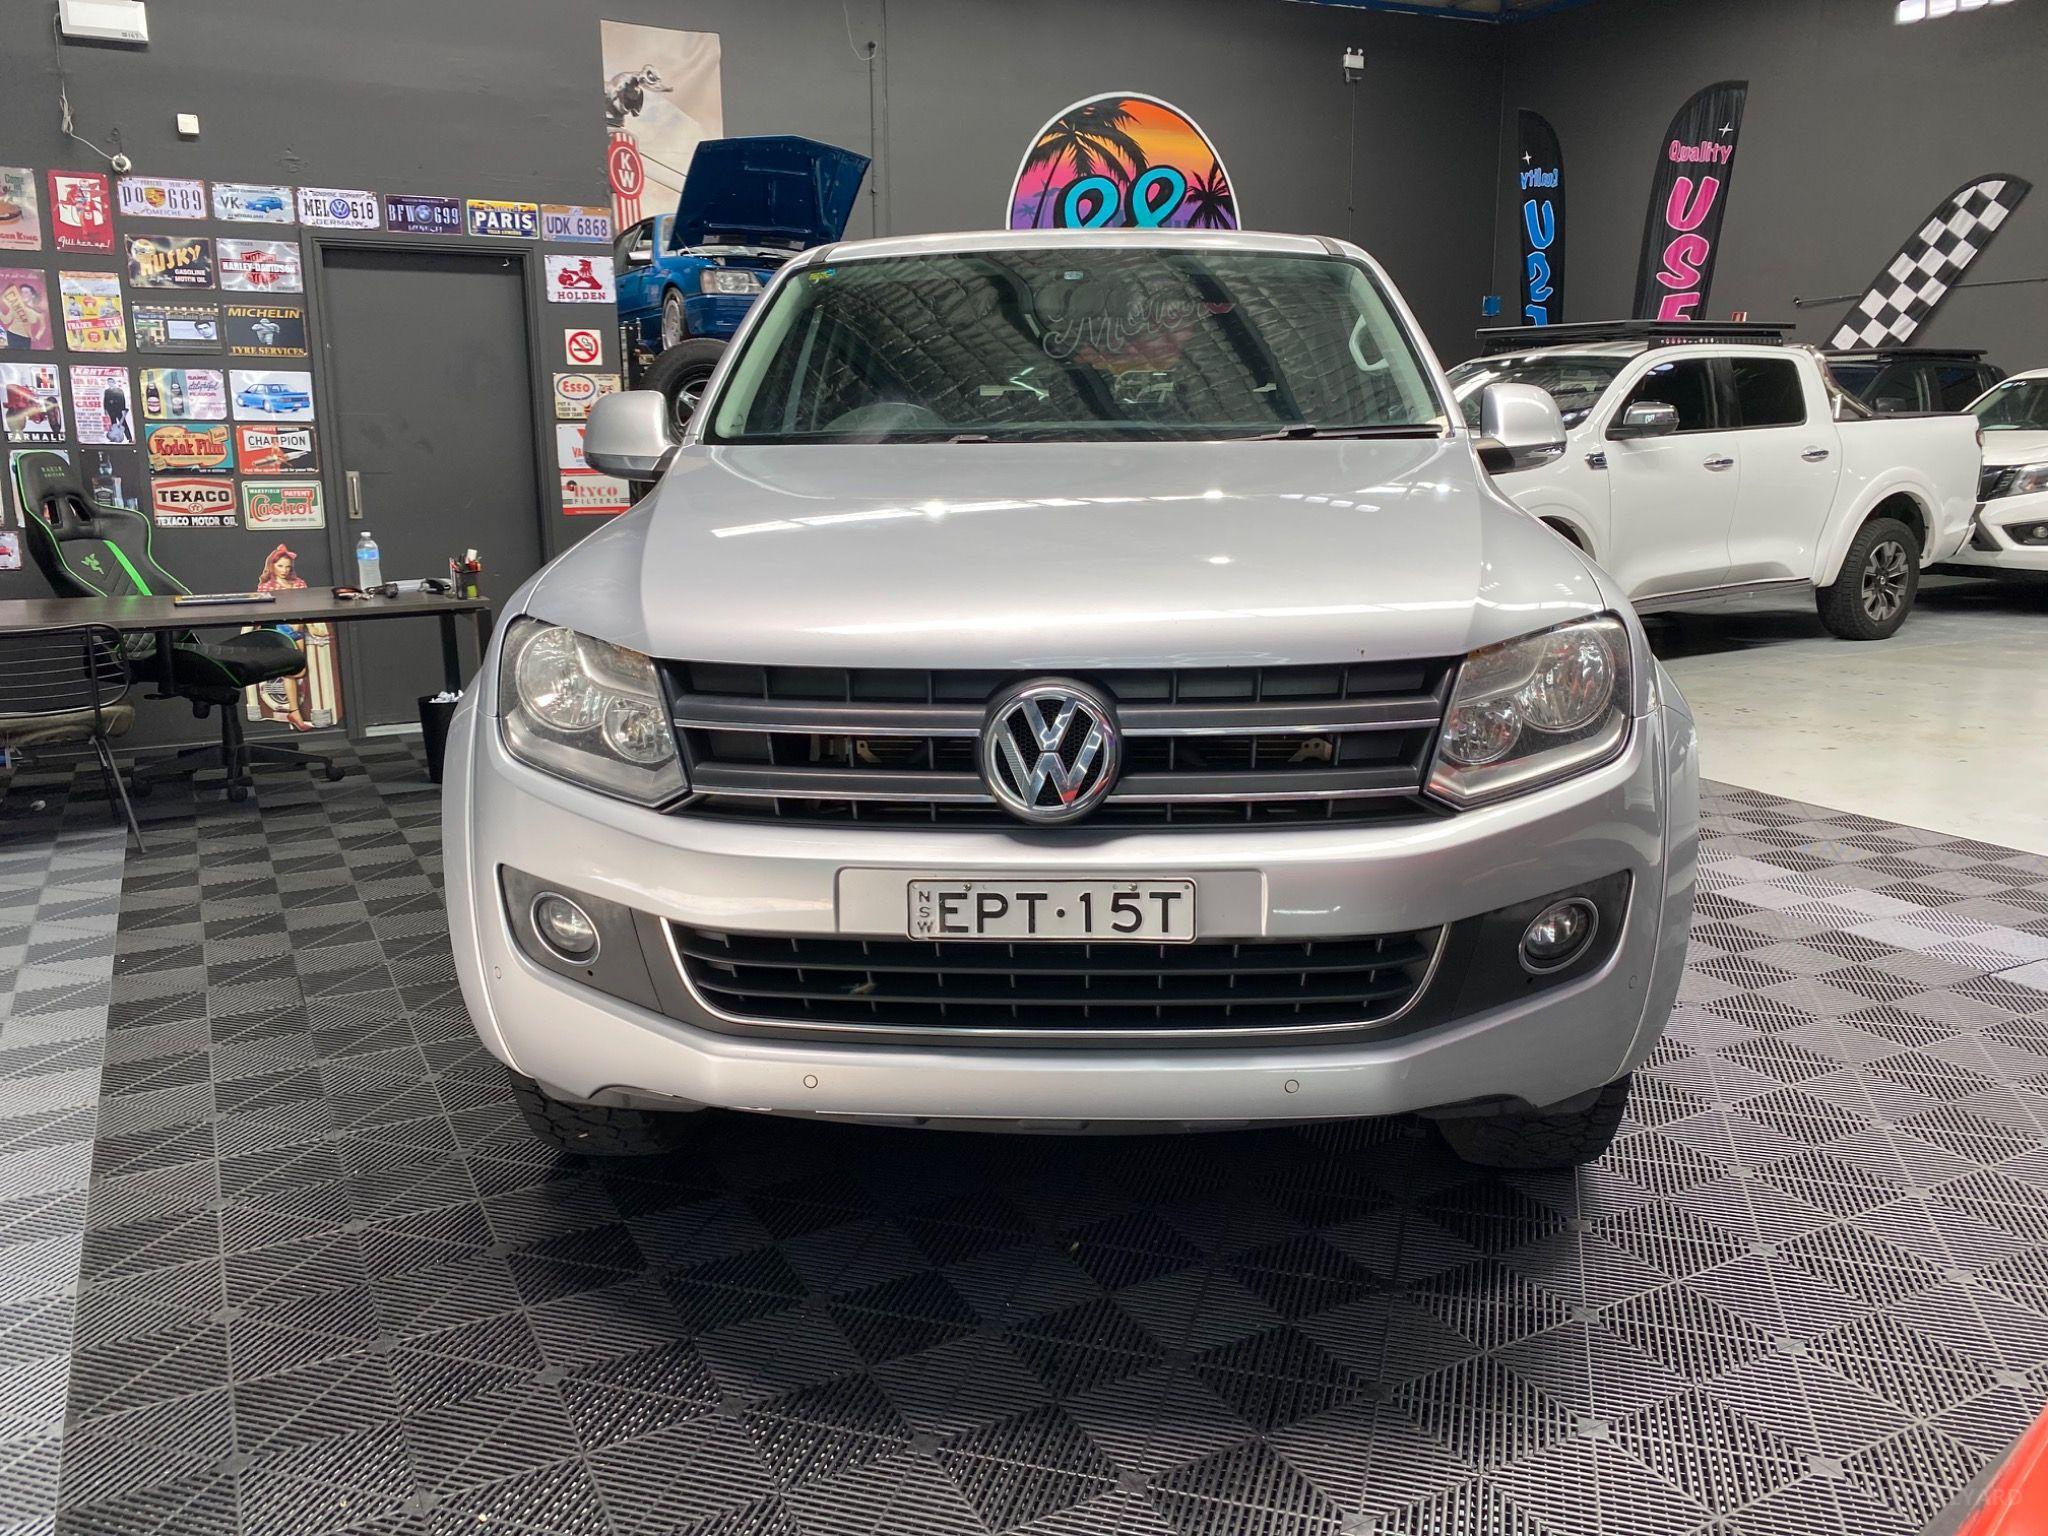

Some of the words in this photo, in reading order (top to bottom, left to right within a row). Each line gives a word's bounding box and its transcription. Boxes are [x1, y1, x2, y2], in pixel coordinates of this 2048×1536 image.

[1669, 140, 1732, 164] Quality
[168, 189, 202, 210] 689
[303, 199, 329, 217] MEL
[351, 202, 373, 219] 618
[434, 207, 459, 224] 699
[475, 211, 532, 229] PARIS
[546, 216, 571, 234] UDK
[577, 218, 607, 236] 6868
[139, 244, 202, 276] HUSKY
[222, 261, 297, 273] HARLEY-DAVIDSON
[557, 292, 606, 300] HOLDEN
[227, 307, 301, 319] MICHELIN
[105, 319, 122, 327] CLAY
[232, 346, 257, 355] TYRE
[259, 346, 304, 355] SERVICES
[562, 380, 590, 393] Esso
[8, 433, 65, 441] FARMALL
[155, 439, 194, 456] Kodak
[195, 439, 224, 456] Film
[158, 490, 230, 502] TEXACO
[574, 486, 617, 497] RYCO
[250, 491, 316, 522] Castrol
[157, 517, 189, 527] TEXACO
[192, 517, 220, 526] MOTOR
